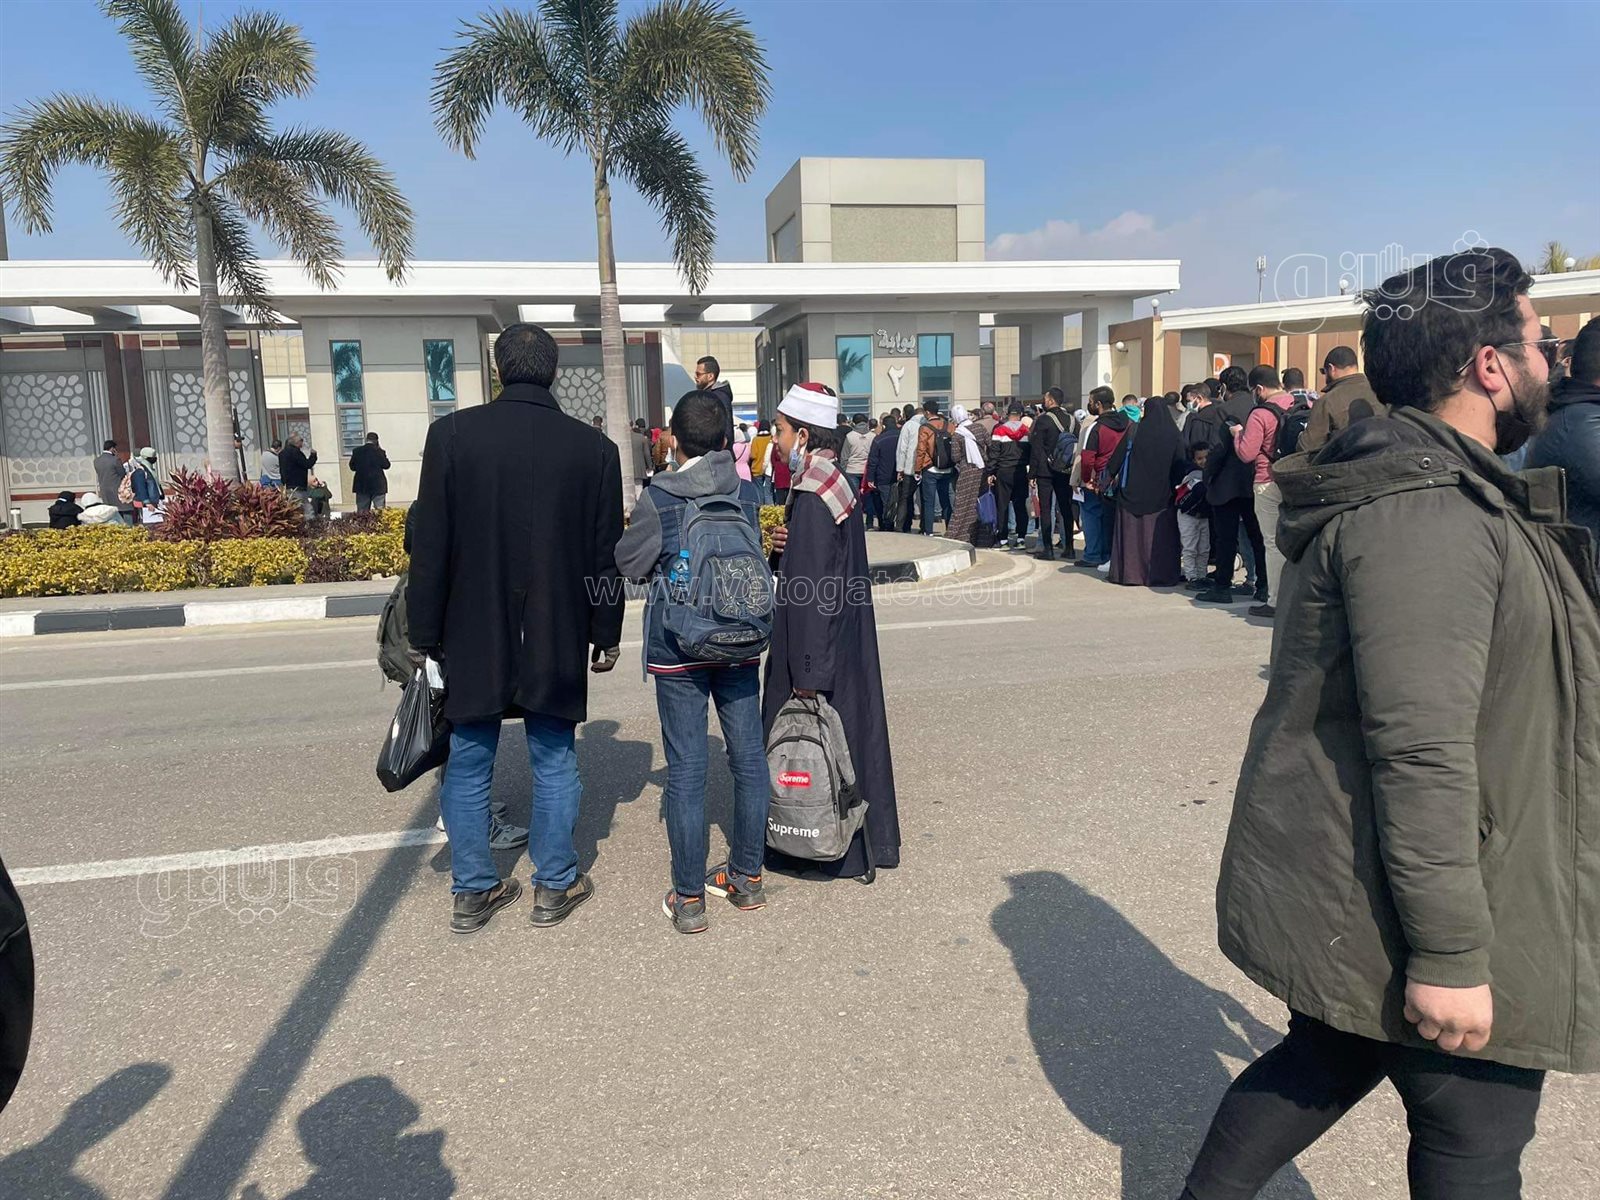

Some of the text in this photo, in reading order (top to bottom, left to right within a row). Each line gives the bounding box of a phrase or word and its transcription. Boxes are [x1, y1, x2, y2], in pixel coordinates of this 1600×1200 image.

[876, 329, 916, 354] بوابة
[887, 364, 905, 396] ٢
[767, 817, 820, 838] Supreme
